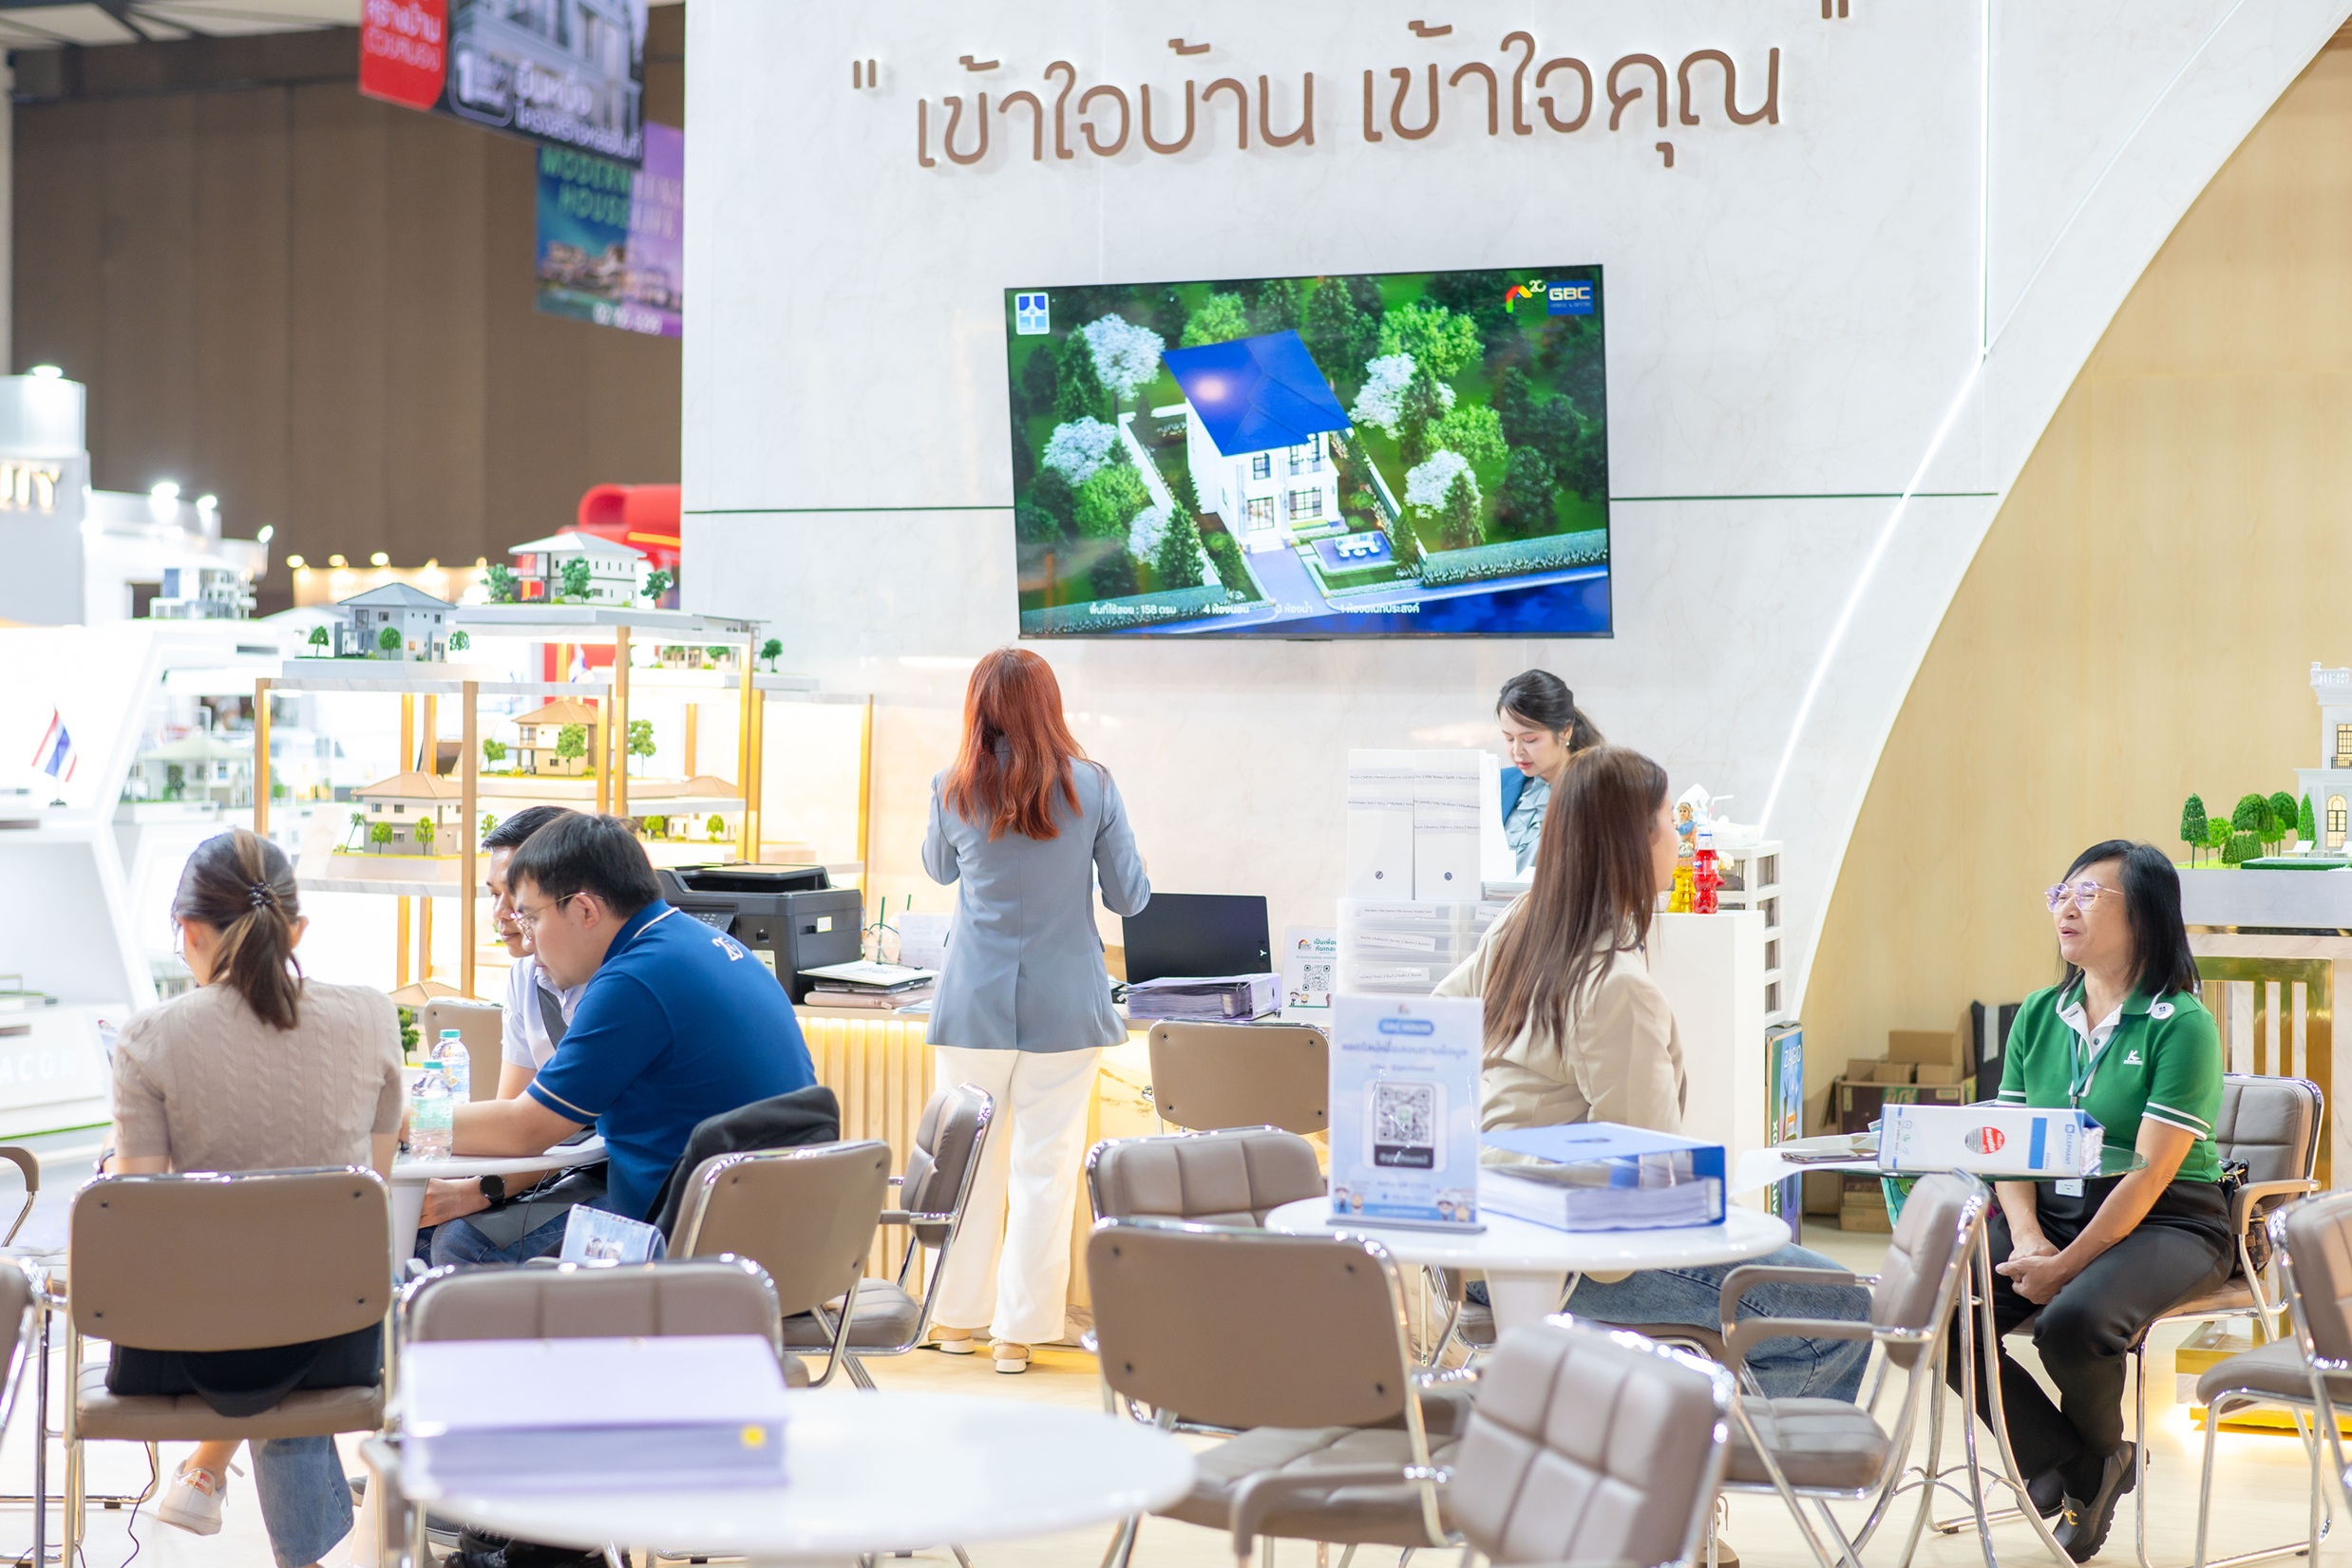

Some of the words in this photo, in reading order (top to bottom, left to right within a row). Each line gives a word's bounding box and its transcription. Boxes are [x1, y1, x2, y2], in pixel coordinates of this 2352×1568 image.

[919, 38, 1315, 168] เข้าใจบ้าน
[1364, 20, 1781, 168] เข้าใจคุณ
[1548, 287, 1591, 301] GBC
[1140, 604, 1158, 614] 158
[1203, 604, 1211, 614] 4
[1212, 603, 1250, 614] ห้องนอน
[2064, 1134, 2073, 1165] ELEPHANT
